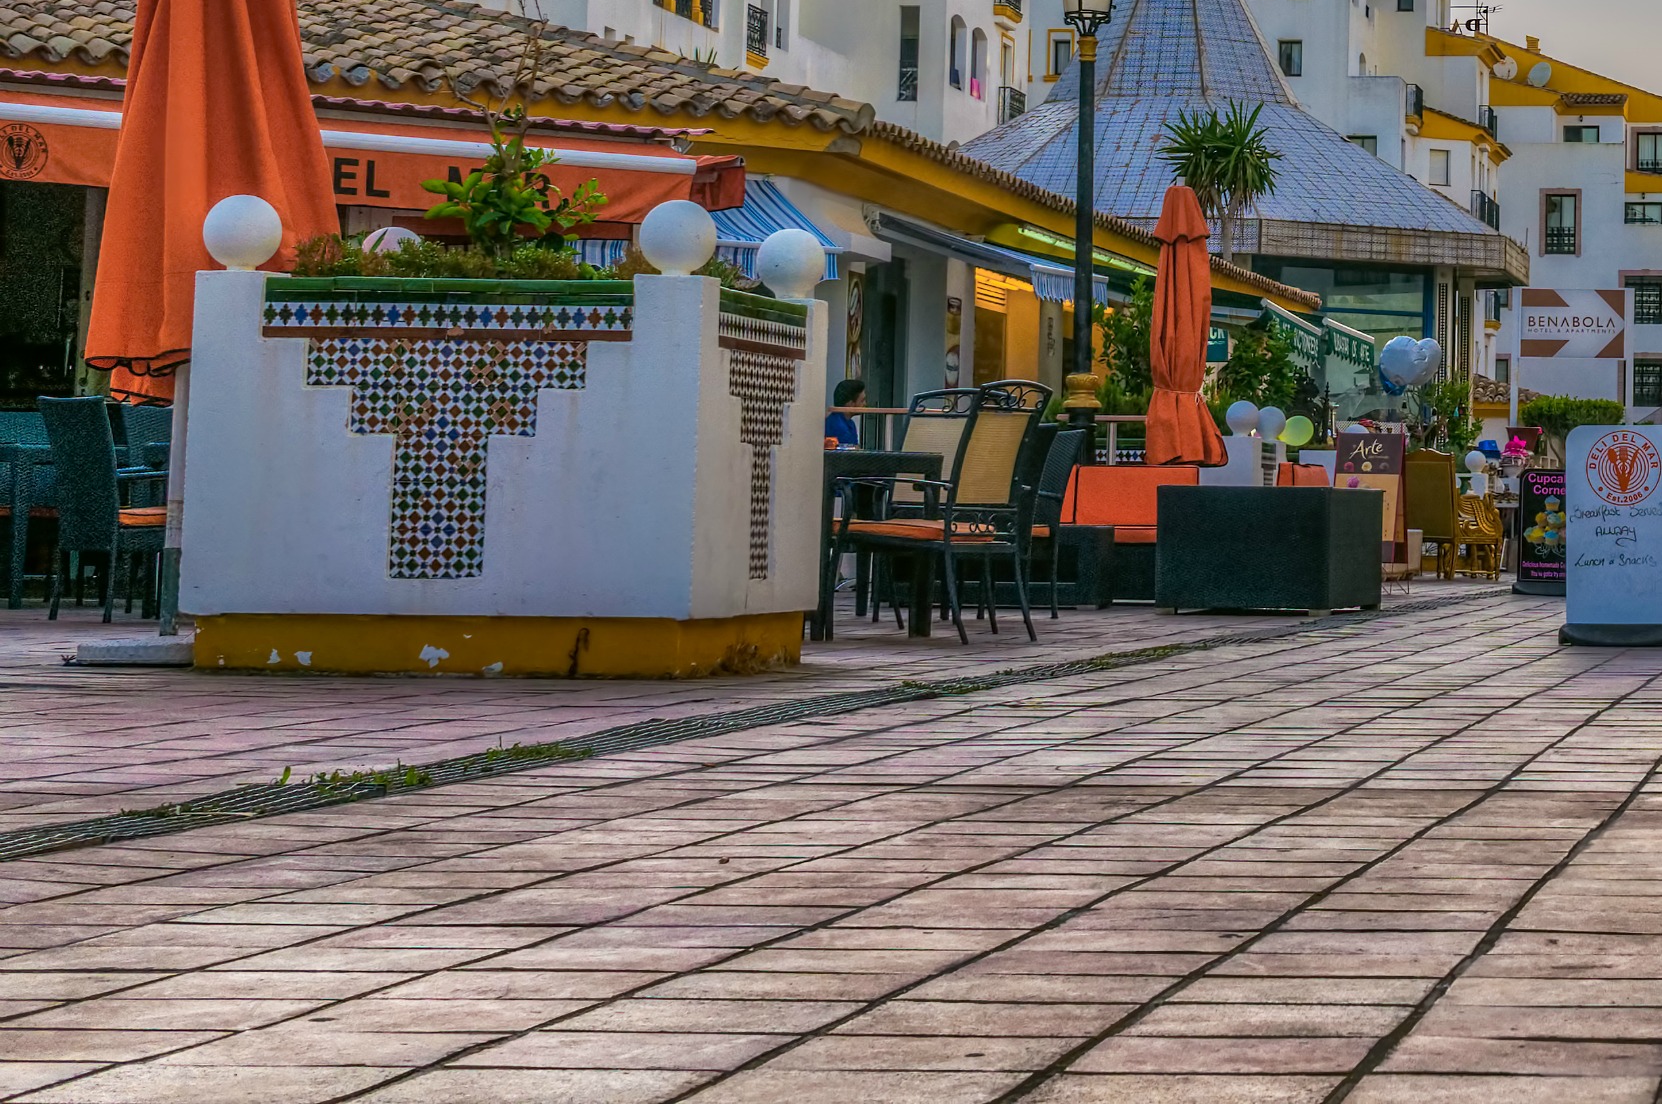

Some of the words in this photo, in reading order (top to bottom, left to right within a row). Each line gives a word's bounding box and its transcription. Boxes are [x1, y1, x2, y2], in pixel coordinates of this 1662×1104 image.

[333, 157, 391, 199] EL
[1527, 316, 1616, 328] BENABOLA
[1348, 438, 1384, 460] Arte
[1588, 440, 1608, 470] DELI
[1611, 433, 1637, 444] DEL
[1641, 442, 1659, 469] MAR
[1527, 473, 1566, 485] Cupca
[1533, 484, 1566, 496] Corne
[1605, 491, 1643, 503] Est.2006
